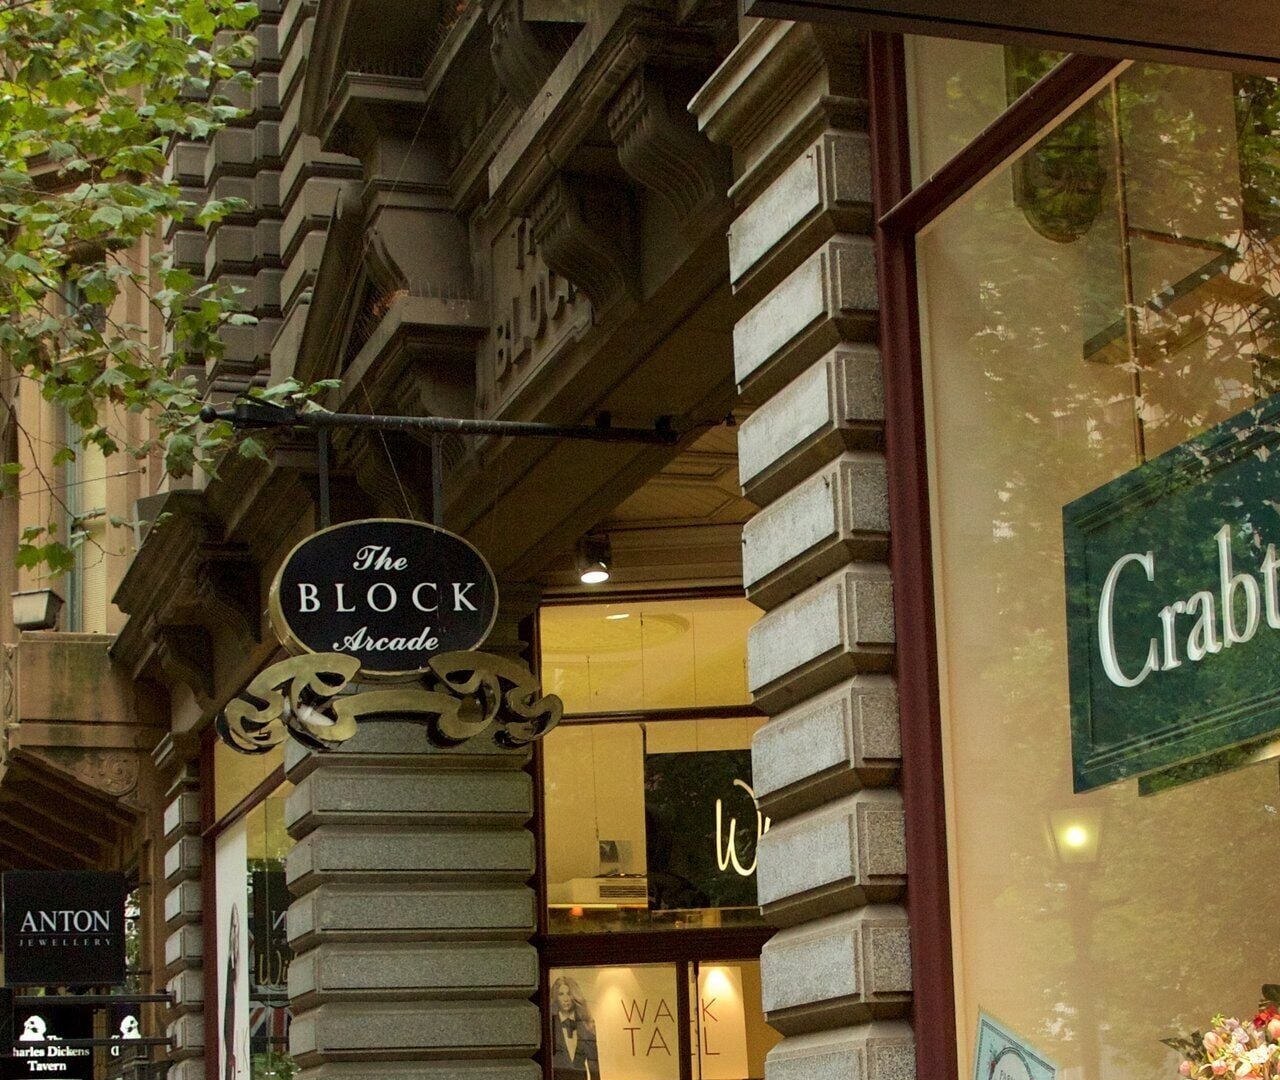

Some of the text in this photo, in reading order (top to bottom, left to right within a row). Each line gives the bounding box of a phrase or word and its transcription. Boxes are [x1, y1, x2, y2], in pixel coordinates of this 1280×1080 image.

[353, 545, 408, 571] The
[297, 582, 478, 613] BLOCK
[333, 626, 439, 651] Arcade
[20, 910, 110, 932] ANTON
[19, 938, 112, 947] JEWELLERY
[621, 998, 718, 1023] WAK
[12, 1046, 90, 1057] harles Dickens
[623, 1027, 720, 1056] TAL
[27, 1061, 67, 1071] Tavern
